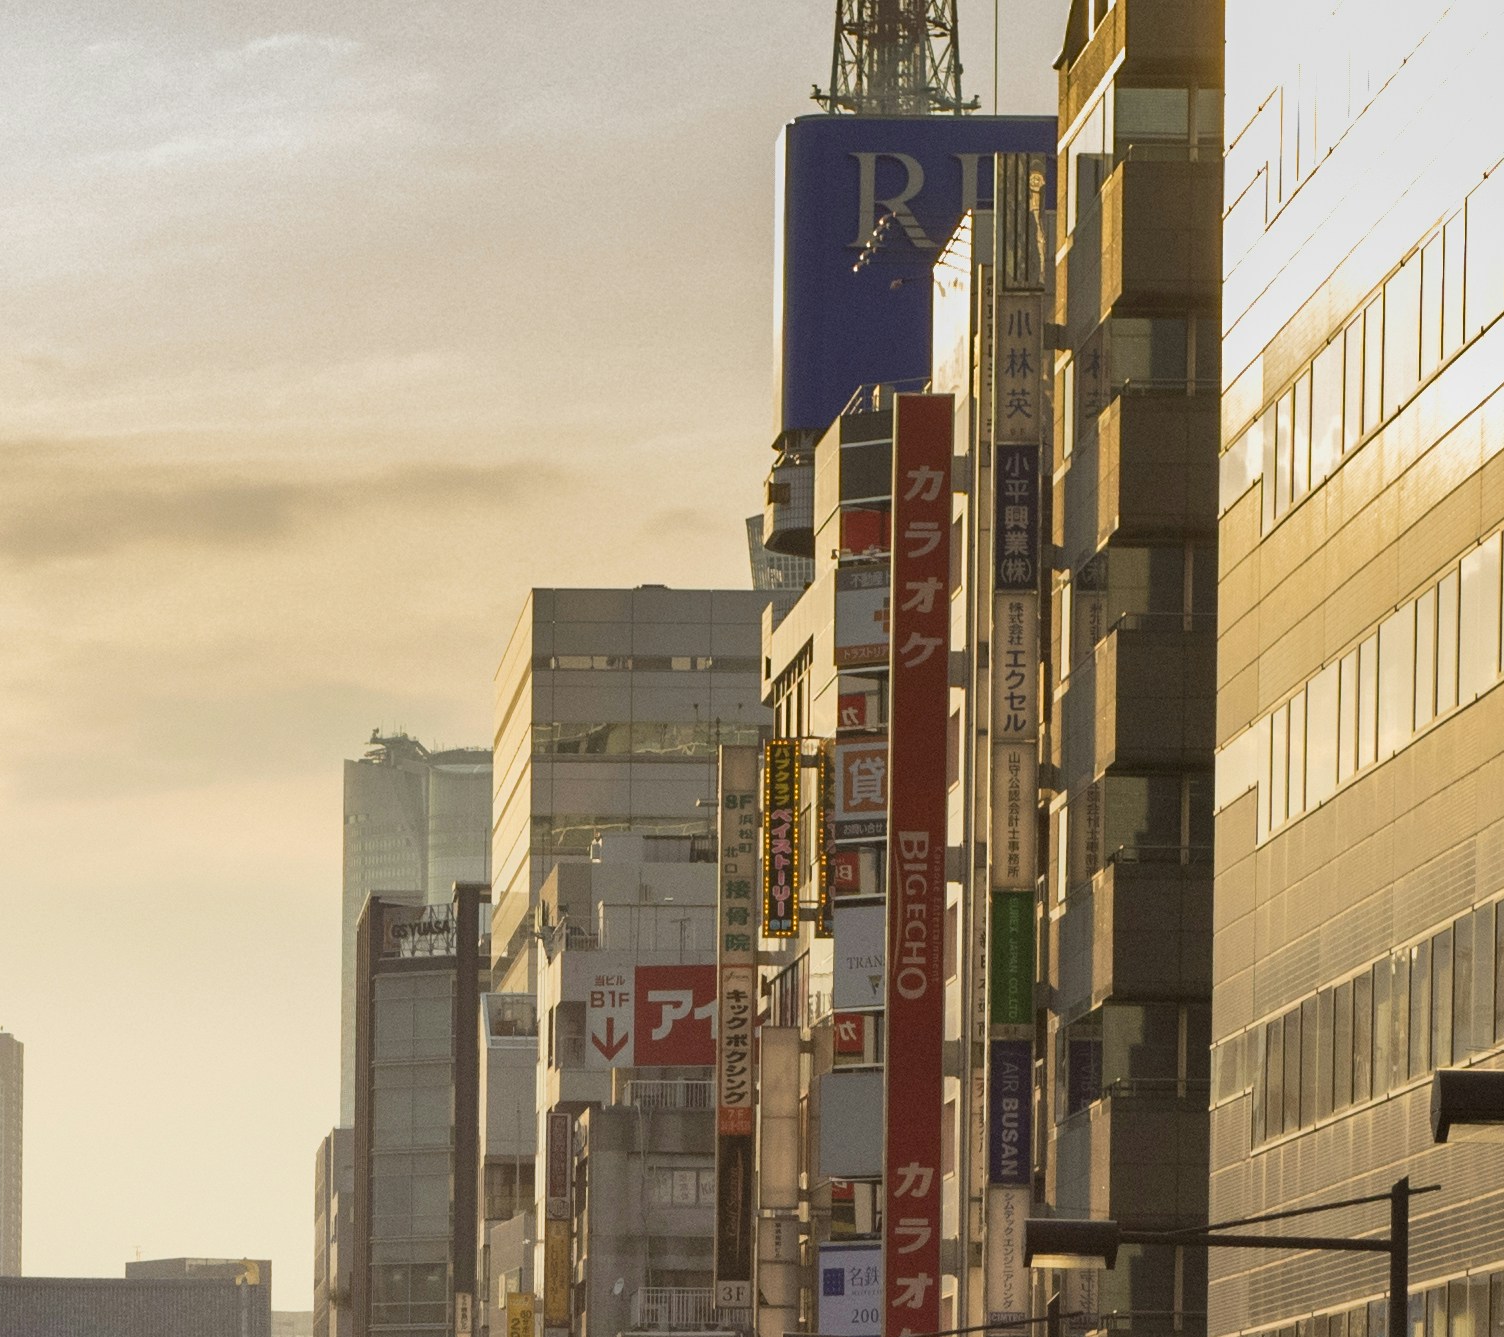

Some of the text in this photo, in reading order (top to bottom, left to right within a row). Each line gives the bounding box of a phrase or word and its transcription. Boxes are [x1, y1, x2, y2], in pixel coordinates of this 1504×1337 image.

[898, 464, 945, 669] カラオケ
[1003, 649, 1027, 732] エクセル
[590, 990, 630, 1009] B1F
[724, 988, 749, 1105] キックボクシング
[1001, 1060, 1020, 1176] AIR BUSAN
[722, 1285, 745, 1302] 3F
